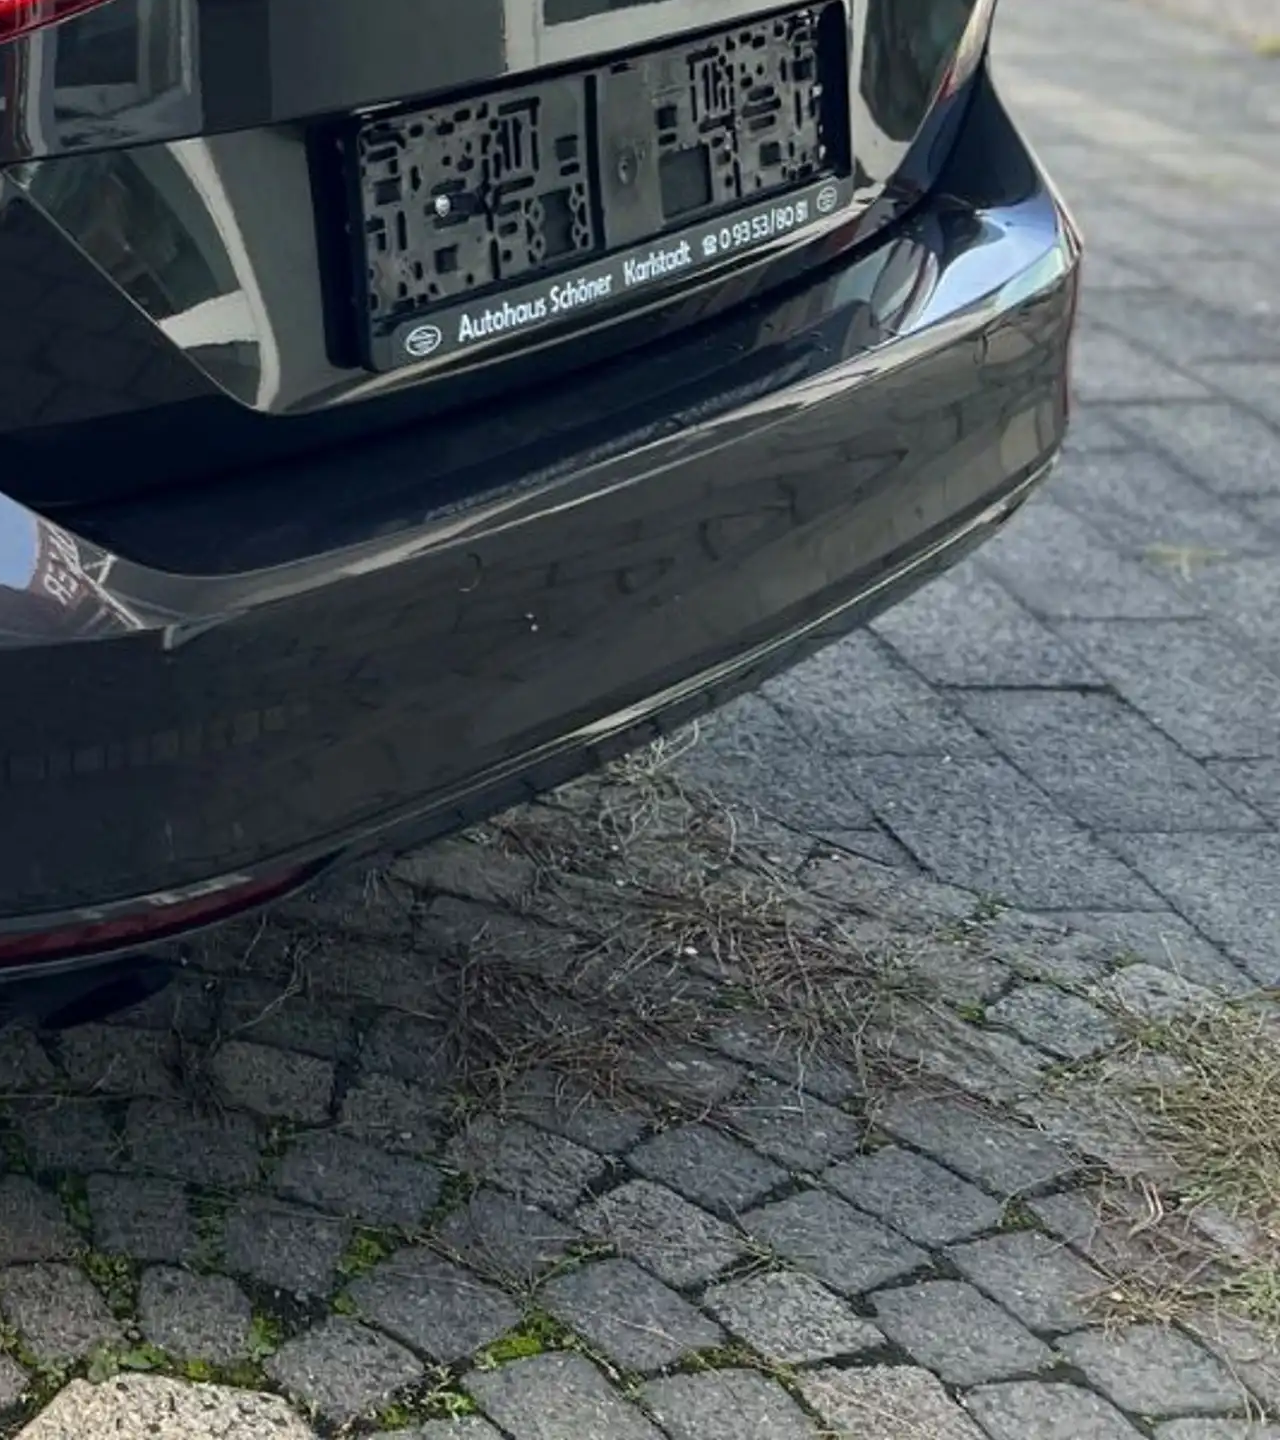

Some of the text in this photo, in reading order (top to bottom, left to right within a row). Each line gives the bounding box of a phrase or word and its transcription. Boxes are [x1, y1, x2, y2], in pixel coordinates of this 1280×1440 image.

[458, 295, 548, 342] Autohaus
[549, 273, 613, 312] Schöner
[622, 239, 693, 286] Karlstadt
